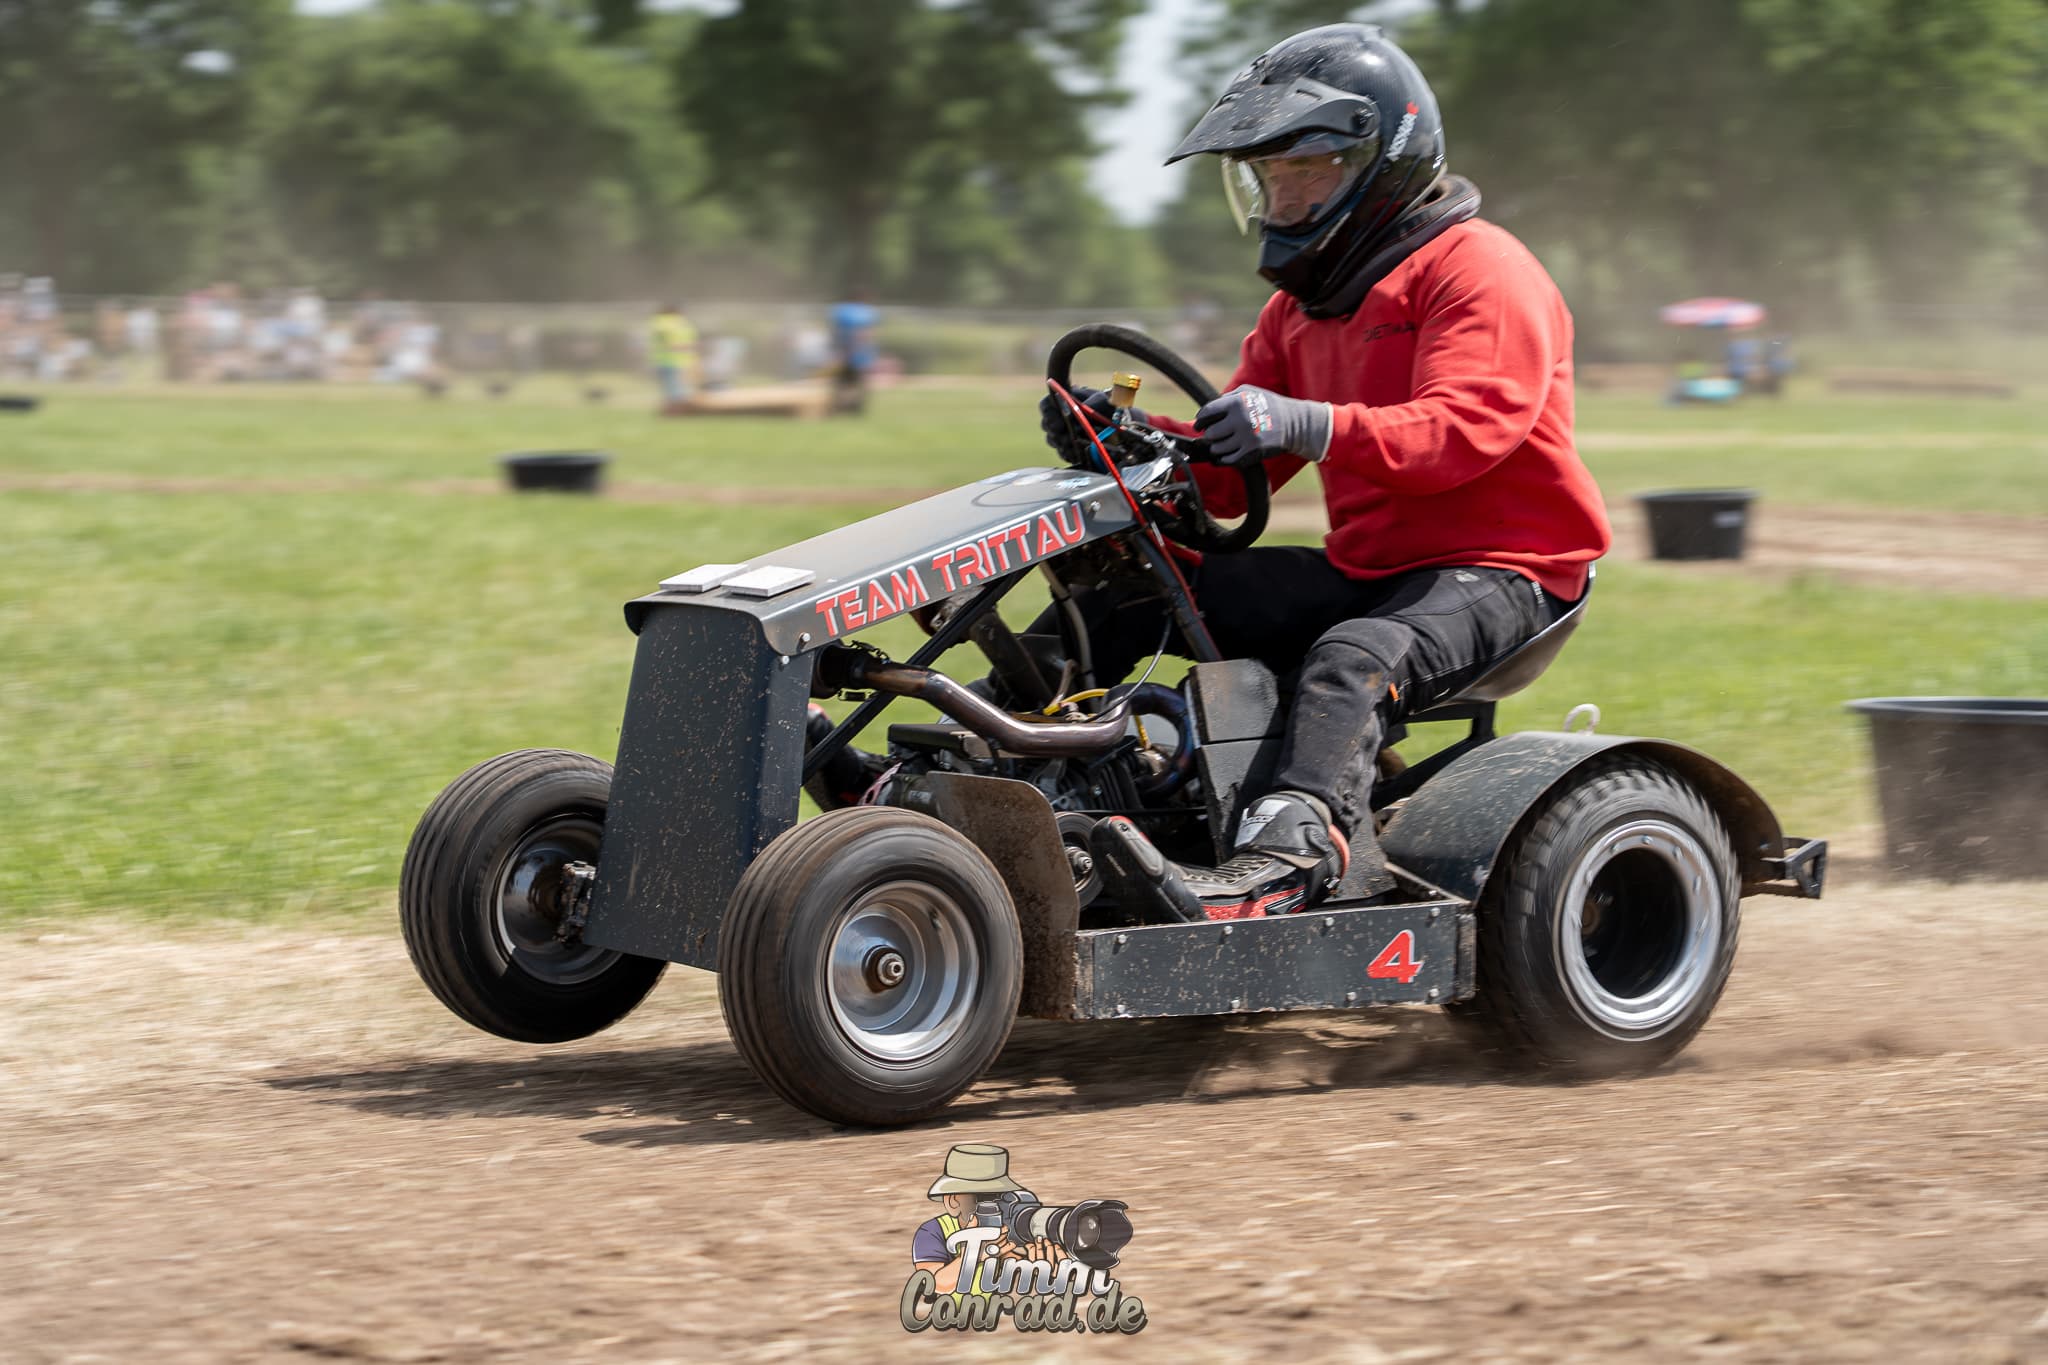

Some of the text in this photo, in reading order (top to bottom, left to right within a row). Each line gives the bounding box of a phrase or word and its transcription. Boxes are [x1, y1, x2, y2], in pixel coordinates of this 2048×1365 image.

[815, 501, 1087, 637] TEAM TRITTAU
[1366, 929, 1424, 983] 4
